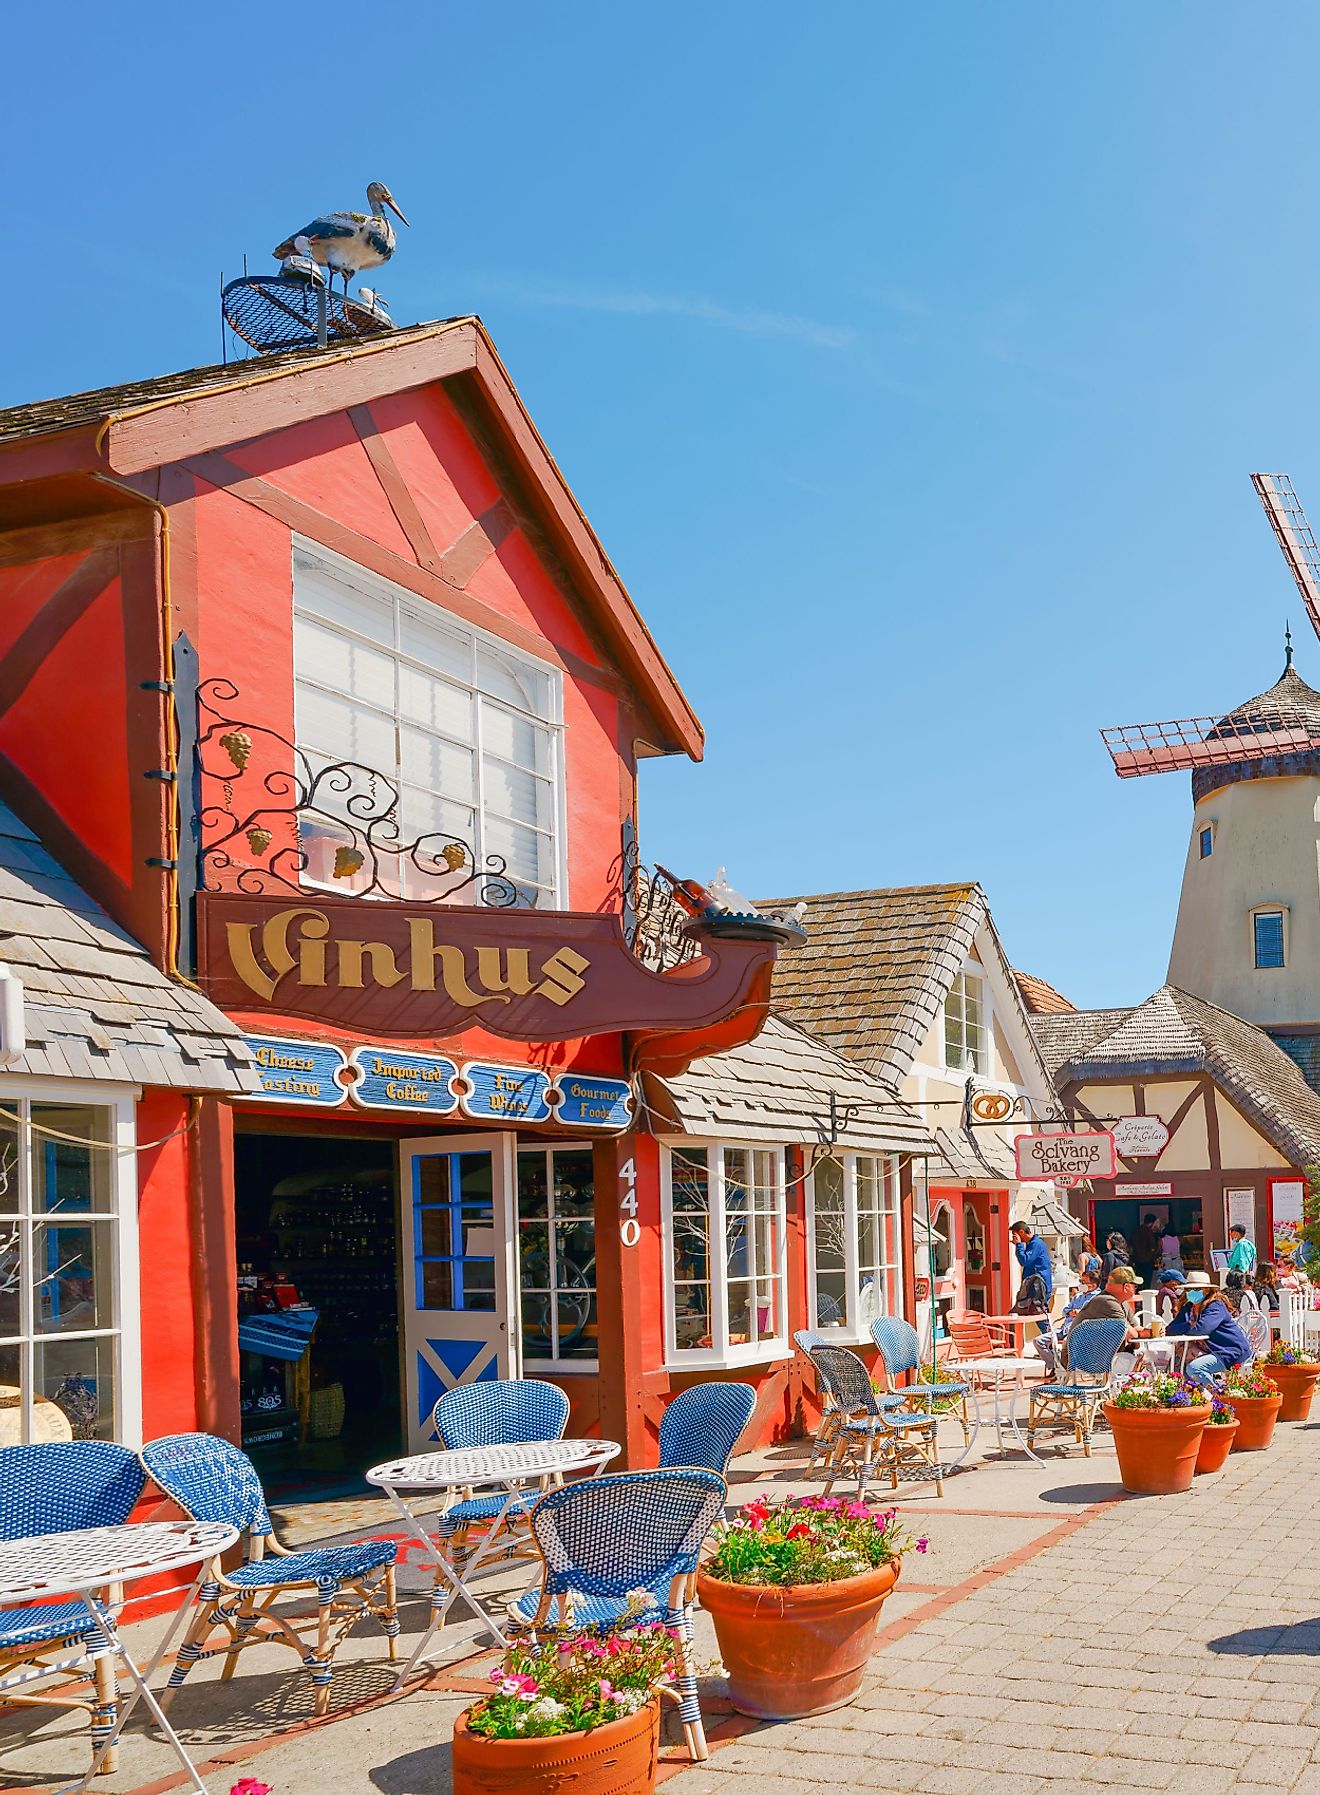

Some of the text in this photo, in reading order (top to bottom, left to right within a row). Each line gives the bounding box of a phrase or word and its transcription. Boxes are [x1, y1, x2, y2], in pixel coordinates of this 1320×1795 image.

[226, 908, 591, 1006] Vinhus
[256, 1047, 316, 1071] Cheese
[372, 1057, 442, 1082] Imported
[258, 1072, 320, 1098] asting
[386, 1081, 430, 1102] Coffee
[494, 1073, 524, 1093] Fine
[570, 1082, 620, 1101] Gourmet
[579, 1102, 613, 1120] Foods
[1056, 1137, 1074, 1146] The
[1040, 1158, 1091, 1174] Bakery
[618, 1157, 641, 1247] 440
